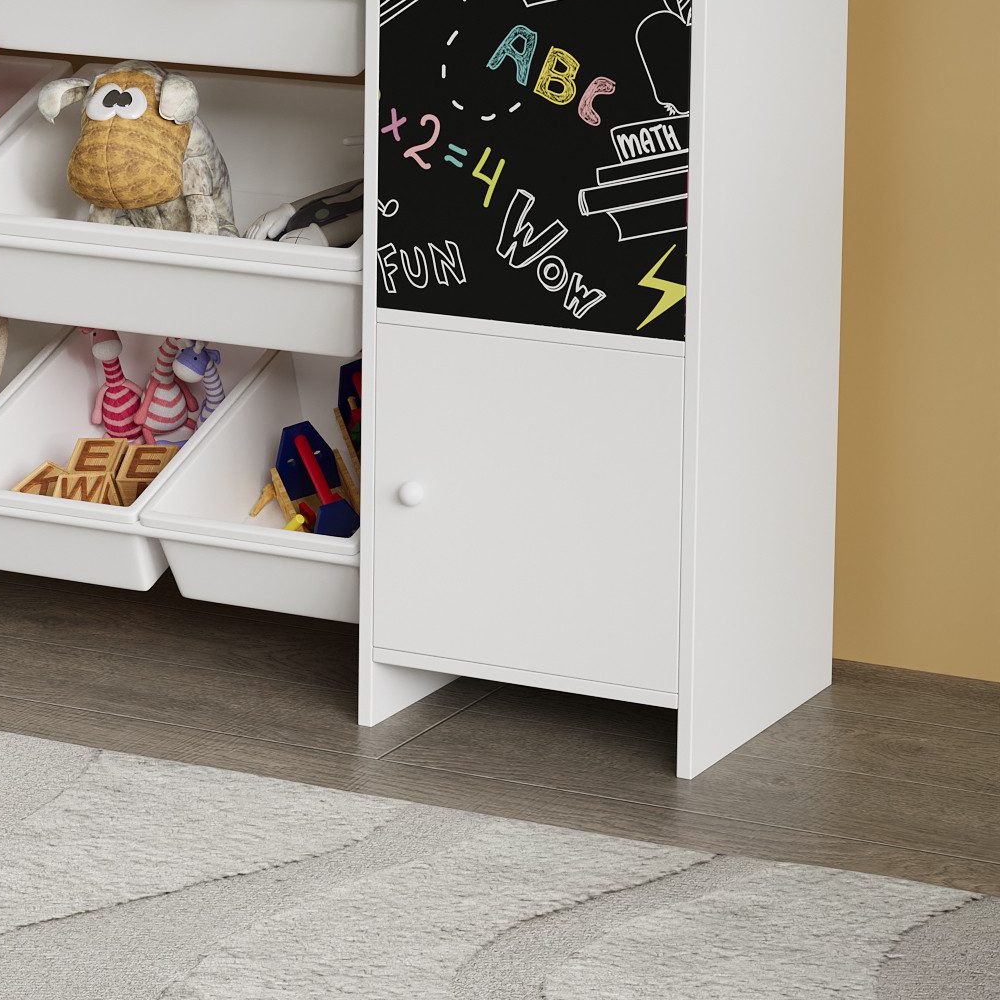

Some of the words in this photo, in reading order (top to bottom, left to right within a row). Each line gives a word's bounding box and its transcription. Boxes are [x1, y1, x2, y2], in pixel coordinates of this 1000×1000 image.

[616, 123, 682, 160] MATH
[377, 239, 467, 294] FUN
[74, 440, 115, 472] E
[126, 446, 168, 479] E
